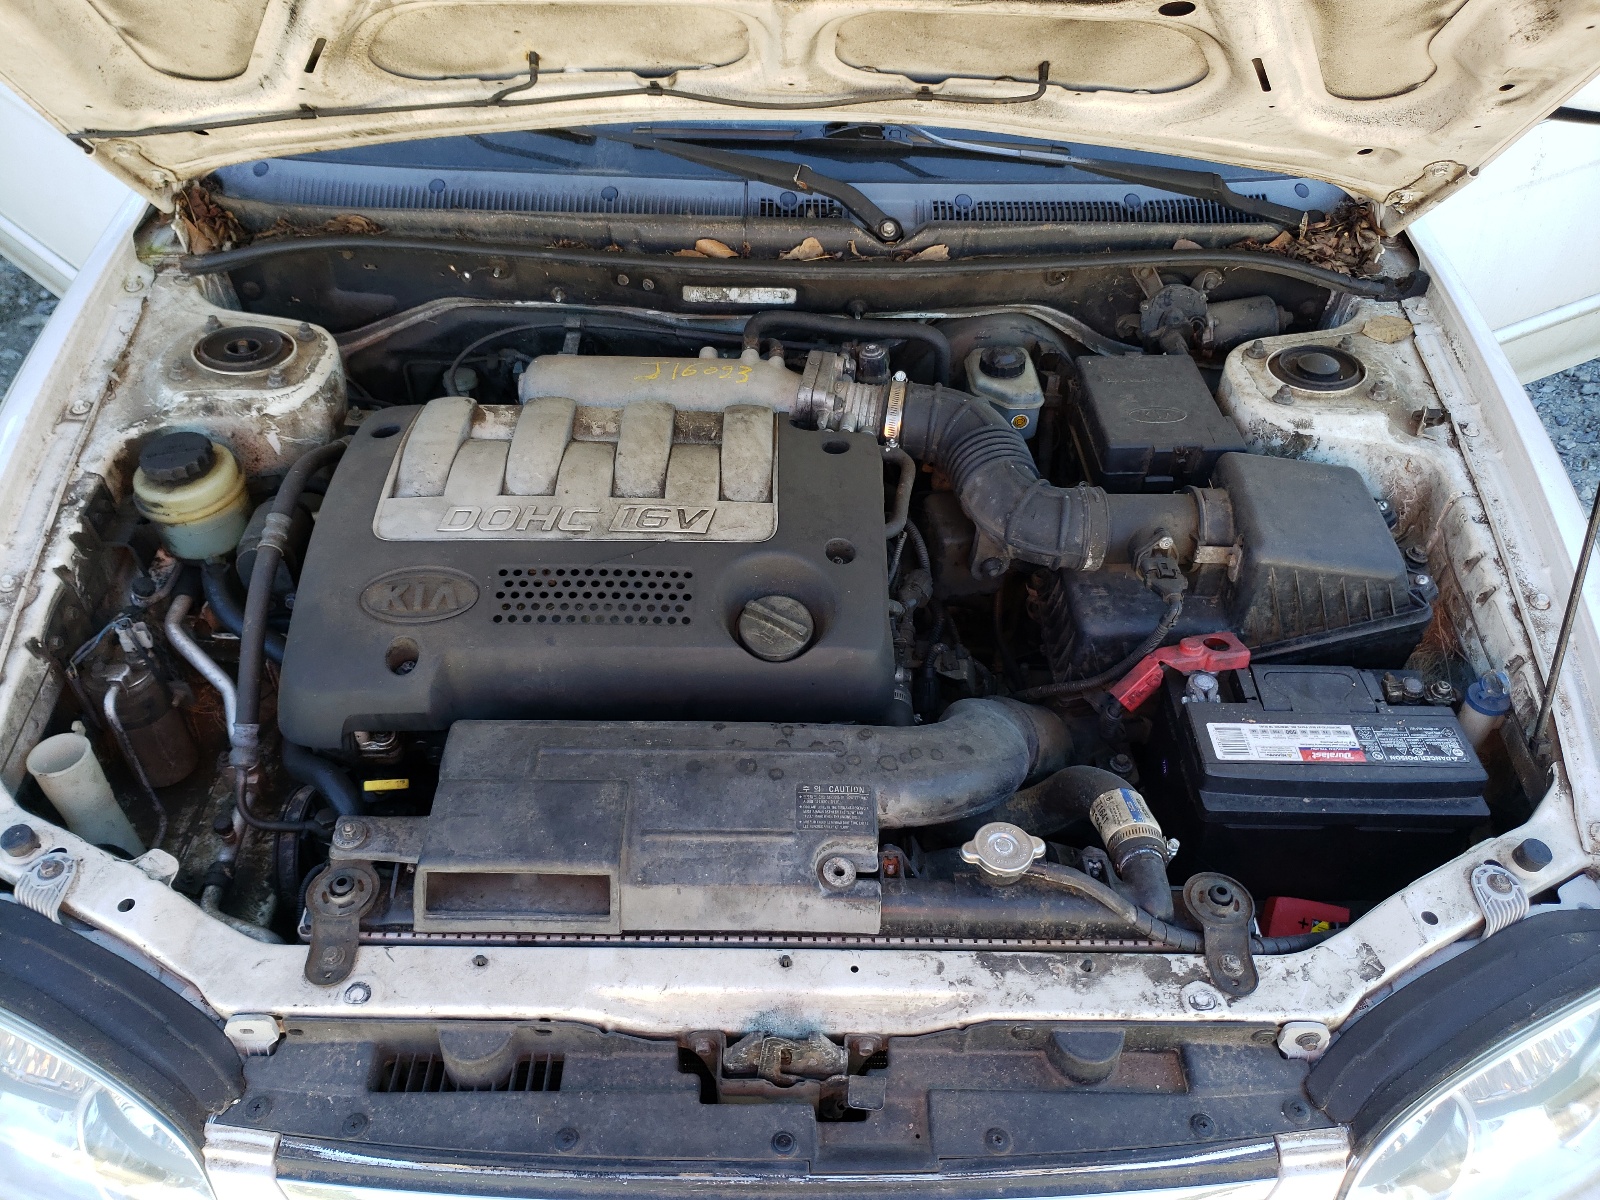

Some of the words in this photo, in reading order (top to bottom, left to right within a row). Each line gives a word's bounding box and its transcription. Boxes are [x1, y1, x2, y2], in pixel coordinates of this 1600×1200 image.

[437, 505, 601, 532] DOHC
[620, 506, 710, 530] 16V
[379, 580, 459, 611] KIA
[1311, 751, 1355, 760] Duralast
[828, 785, 865, 794] CAUTION
